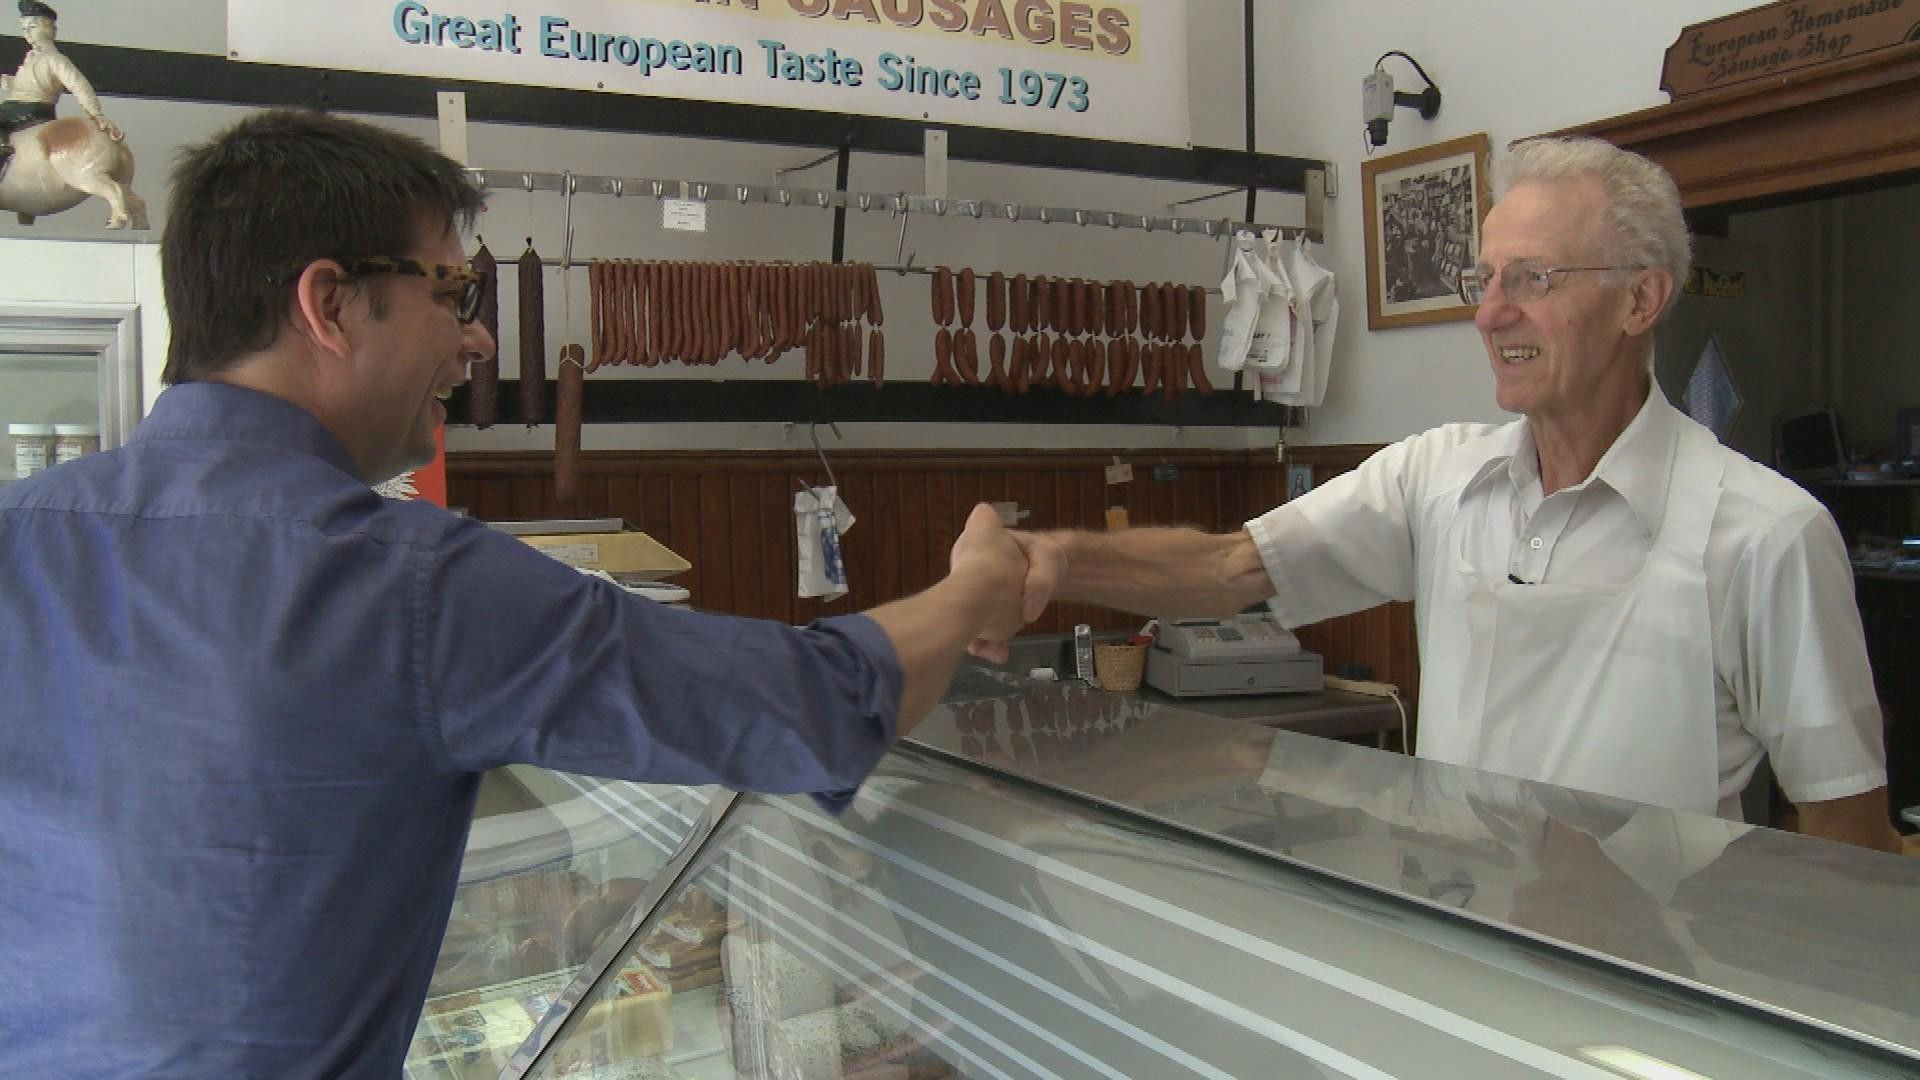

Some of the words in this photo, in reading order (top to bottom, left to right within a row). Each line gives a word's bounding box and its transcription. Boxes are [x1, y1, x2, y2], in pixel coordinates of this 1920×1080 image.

[393, 0, 521, 54] Great
[540, 15, 742, 76] European
[758, 40, 862, 86] Taste
[877, 52, 981, 100] Since
[998, 67, 1089, 112] 1973
[1689, 31, 1777, 67] European
[1708, 48, 1793, 82] Sausage
[1800, 32, 1852, 57] Shop
